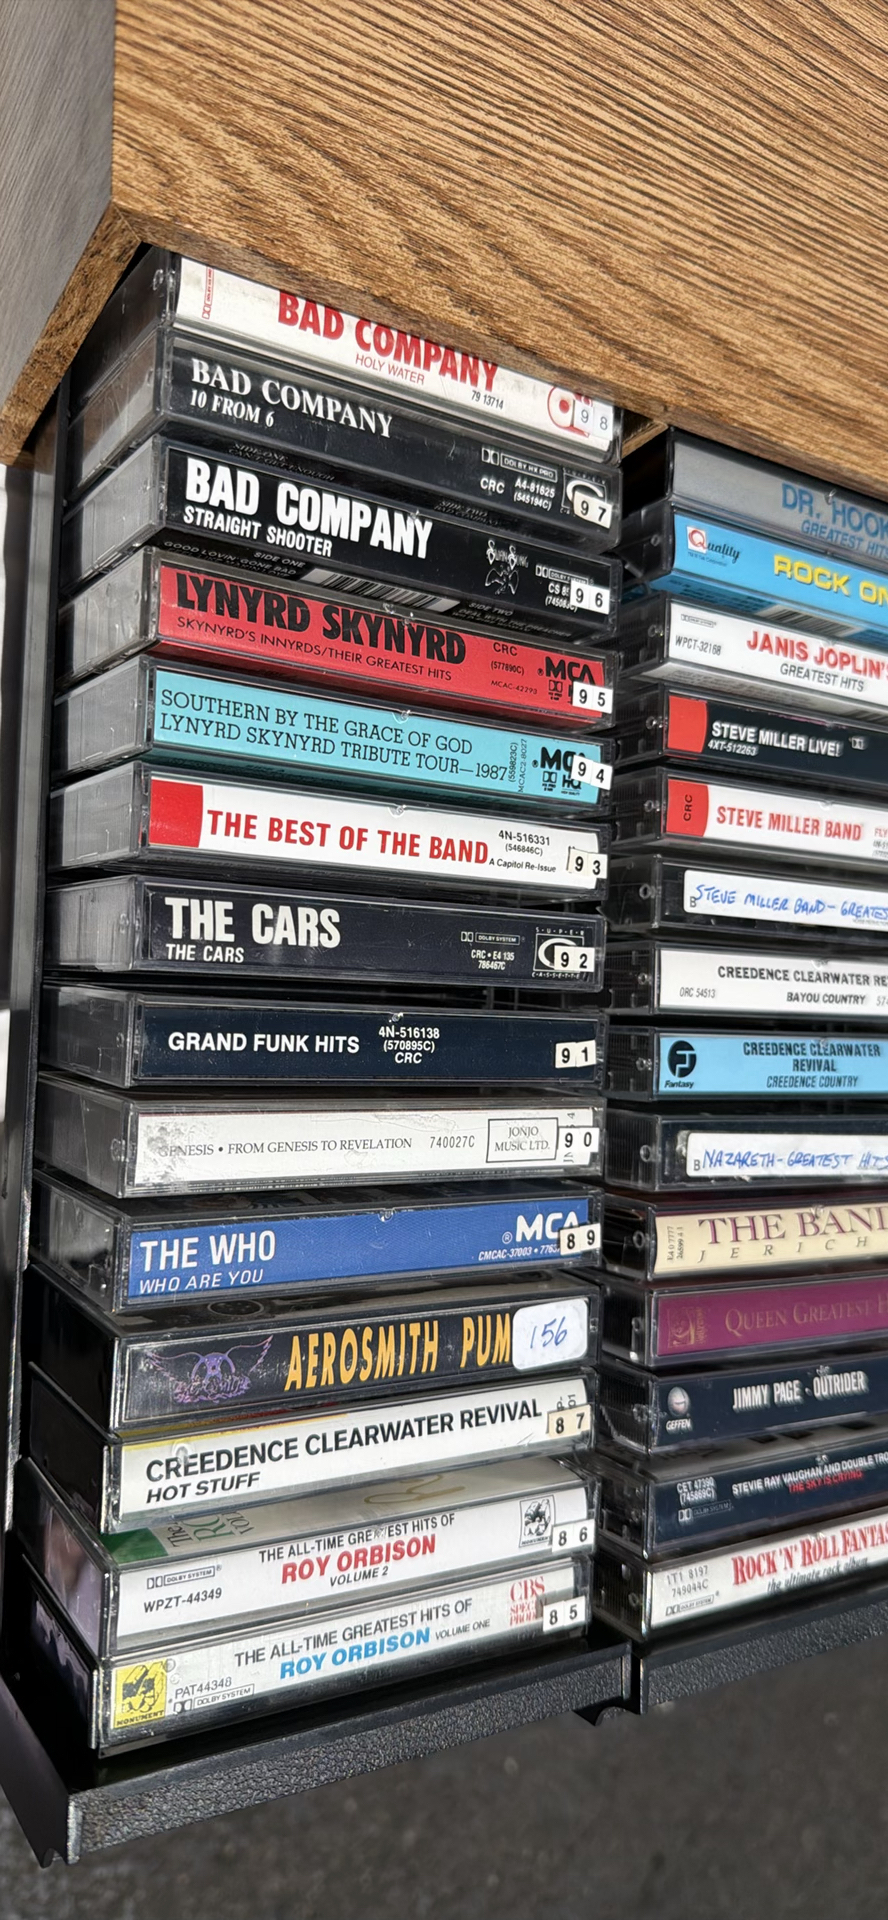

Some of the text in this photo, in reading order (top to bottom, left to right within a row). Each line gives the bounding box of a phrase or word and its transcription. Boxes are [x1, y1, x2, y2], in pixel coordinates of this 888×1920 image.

[278, 289, 498, 392] BAD COMPANY
[355, 353, 425, 385] HOLY WATER
[190, 389, 275, 428] 10 FROM 6
[191, 358, 393, 439] BAD COMPANY
[471, 390, 504, 410] 79 13714
[480, 478, 556, 498] CRC A4-81625
[782, 483, 821, 519] DR.
[185, 457, 433, 559] BAD COMPANY
[183, 505, 333, 558] STRAIGHT SHOOTER
[801, 520, 863, 552] GREATEST
[774, 554, 850, 596] ROCK
[176, 573, 466, 665] LYNYRD SKYNYRD
[177, 616, 452, 681] SKYNYRD'S INNYRDS/THEIR GREATEST HITS
[493, 642, 518, 657] CRC
[746, 630, 809, 662] JANIS
[491, 660, 525, 676] (577890C)
[780, 664, 864, 693] GREATEST HITS
[491, 680, 538, 695] MCAC-42293
[161, 689, 473, 754] SOUTHERN BY THE GRACE OF GOD
[160, 712, 411, 767] LYNYRD SKYNYRD TRIBUTE
[711, 721, 842, 757] STEVE MILLER LIVE!
[207, 810, 489, 864] THE BEST OF THE BAND
[716, 806, 862, 841] STEVE MILLER BAND
[498, 829, 551, 846] 4N-516331
[505, 844, 543, 857] (546846C)
[489, 857, 557, 873] A Capitol Re-Issue
[695, 884, 788, 912] STEVE MILLER
[164, 897, 341, 948] THE CARS
[165, 943, 244, 963] THE CARS
[471, 949, 515, 961] CRC E4 135
[717, 965, 870, 986] CREEDENCE CLEARWATER
[679, 987, 716, 999] ORC 54513
[786, 992, 866, 1005] BAYOU COUNTRY
[168, 1031, 360, 1054] GRAND FUNK HITS
[378, 1025, 440, 1039] 4N-516138
[383, 1039, 436, 1053] (570895C)
[394, 1052, 422, 1064] CRC
[743, 1042, 881, 1057] CREEDENCE CLEARWATER
[792, 1059, 836, 1072] REVIVAL
[664, 1080, 694, 1089] Fantasy
[766, 1075, 858, 1088] CREEDENCE COUNTRY
[495, 1140, 551, 1152] MUSIC LTD.
[508, 1126, 539, 1139] JONJO
[158, 1135, 475, 1158] GENESIS FROM GENESIS TO REVELATION 740027C
[698, 1213, 786, 1245] THE
[139, 1230, 276, 1272] THE WHO
[478, 1246, 532, 1261] CMCAC-37003
[139, 1268, 264, 1294] WHO ARE YOU
[530, 1316, 568, 1349] 156
[284, 1319, 439, 1392] AEROSMITH
[733, 1371, 866, 1409] JIMMY PAGE OUTRIDER
[666, 1419, 691, 1431] GEFFEN
[146, 1437, 299, 1482] CREEDENCE
[305, 1412, 454, 1456] CLEARWATER
[460, 1398, 542, 1430] REVIVAL
[146, 1471, 261, 1504] HOT STUFF
[677, 1481, 692, 1494] CET
[732, 1456, 873, 1495] STEVIE RAY VAUGHAN AND DOUBLE
[788, 1482, 804, 1494] THE
[806, 1477, 823, 1489] SKY
[832, 1470, 862, 1485] CRYING
[259, 1513, 456, 1563] THE ALL-TIME HITS OF
[281, 1534, 436, 1584] ROY ORBISON
[732, 1552, 778, 1586] ROCK
[800, 1535, 839, 1568] ROLL
[330, 1565, 389, 1587] VOLUME 2
[767, 1557, 868, 1592] the ultimate rock album
[144, 1587, 222, 1613] WPZT-44349
[235, 1598, 473, 1667] THE GREATEST HITS OF
[280, 1618, 491, 1680] ROY ORBISON VOLUME ONE
[175, 1676, 233, 1701] PAT44348
[197, 1686, 251, 1706] DOLBY SYSTEM
[116, 1710, 164, 1726] MONUMENT
